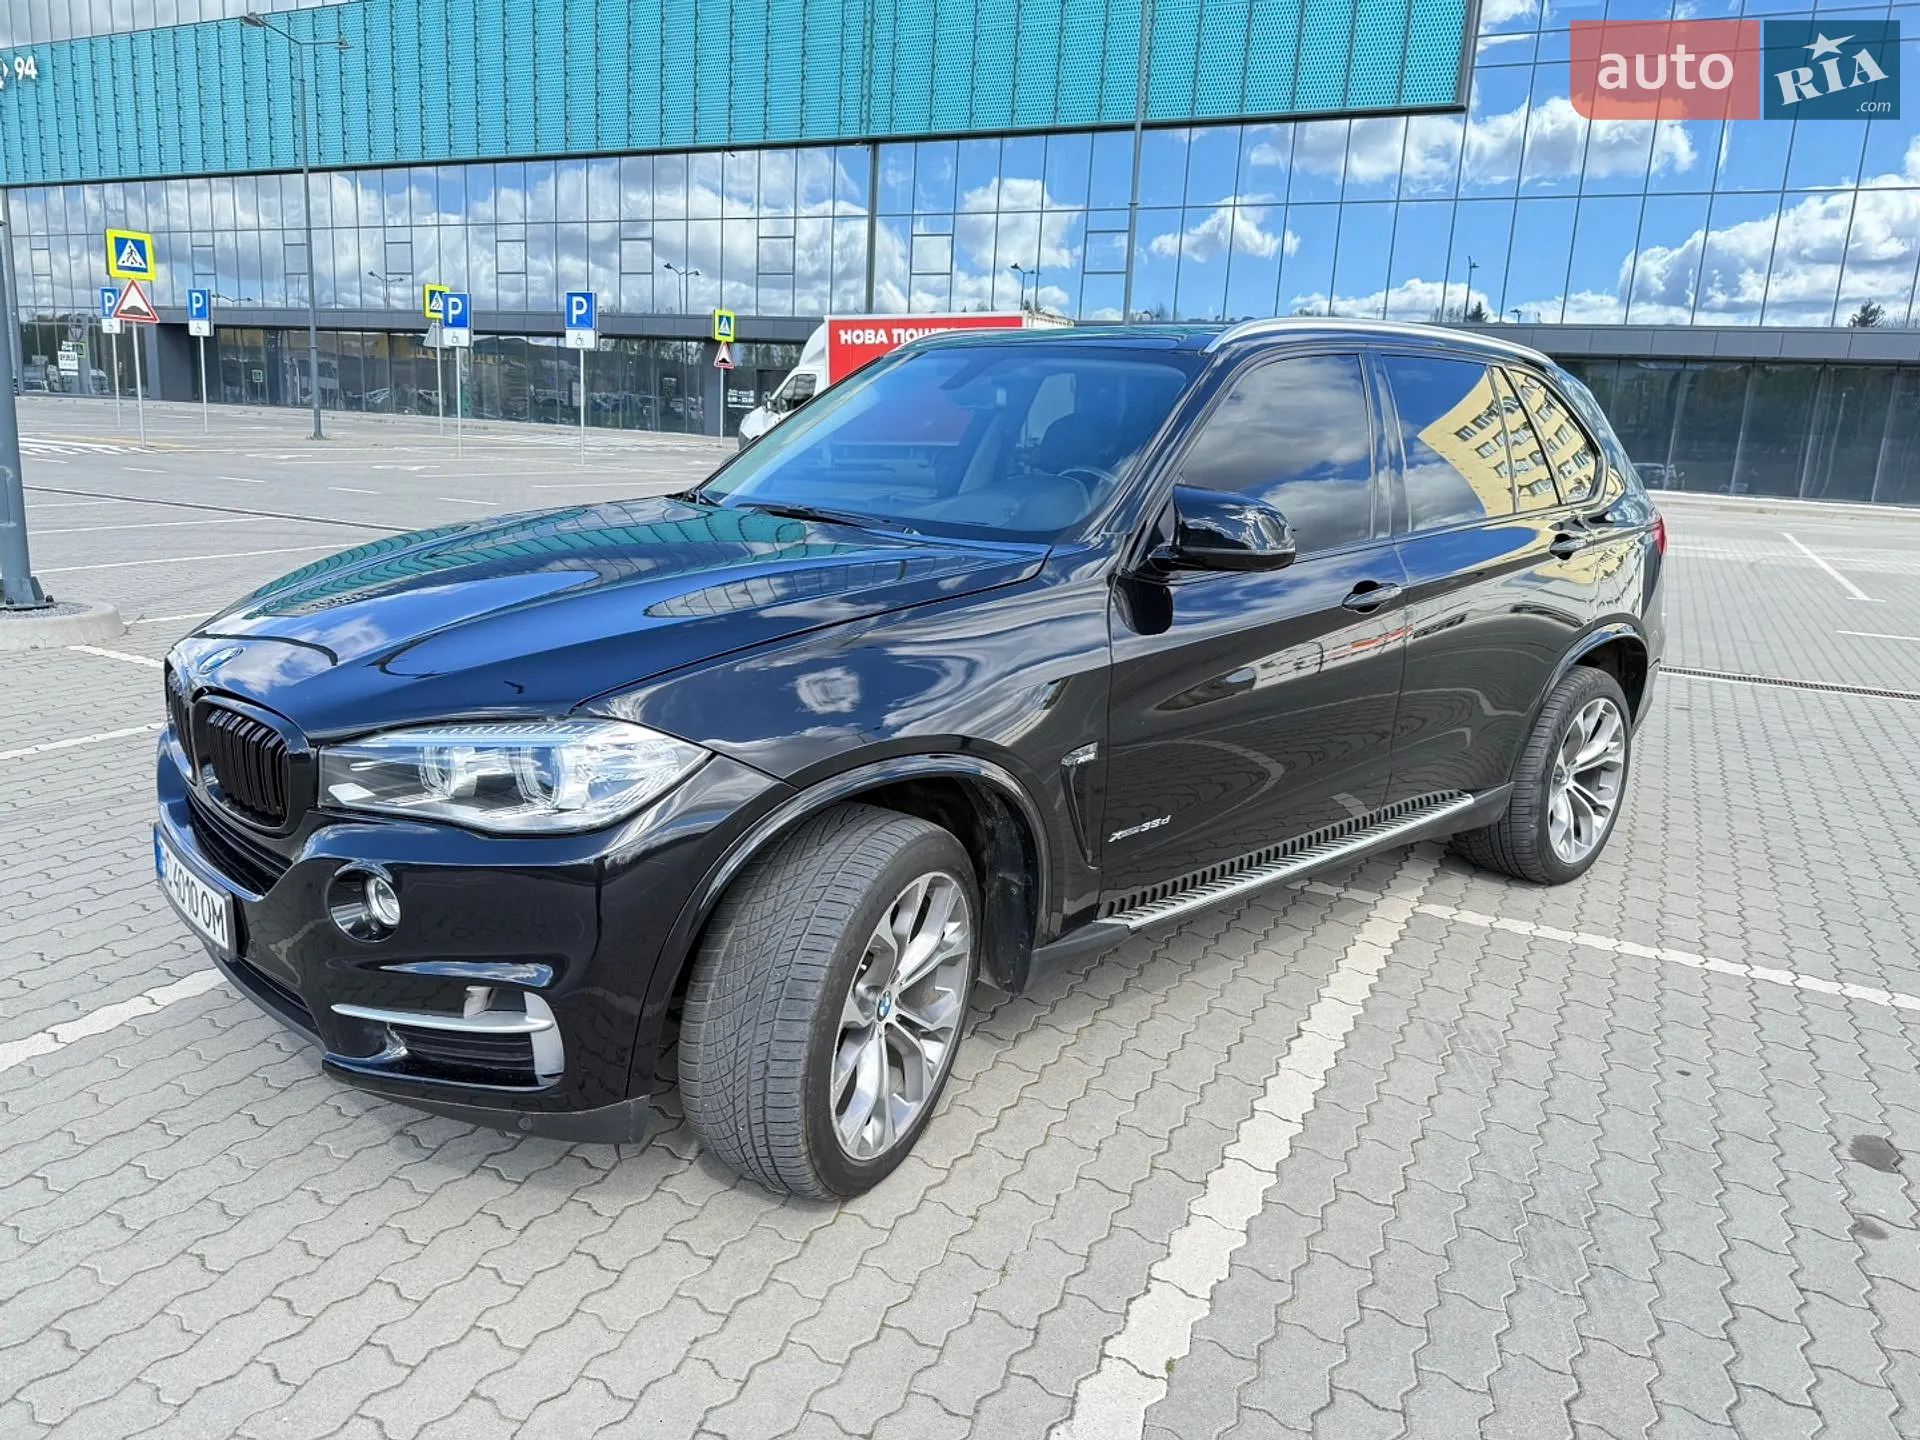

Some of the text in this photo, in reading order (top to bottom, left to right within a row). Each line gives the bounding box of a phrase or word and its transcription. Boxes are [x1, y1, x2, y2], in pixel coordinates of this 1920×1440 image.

[14, 56, 38, 80] 94
[103, 292, 115, 315] P
[191, 292, 204, 316] P
[447, 297, 463, 324] P
[571, 296, 588, 325] P
[839, 328, 888, 345] НОВА
[200, 890, 226, 942] OM
